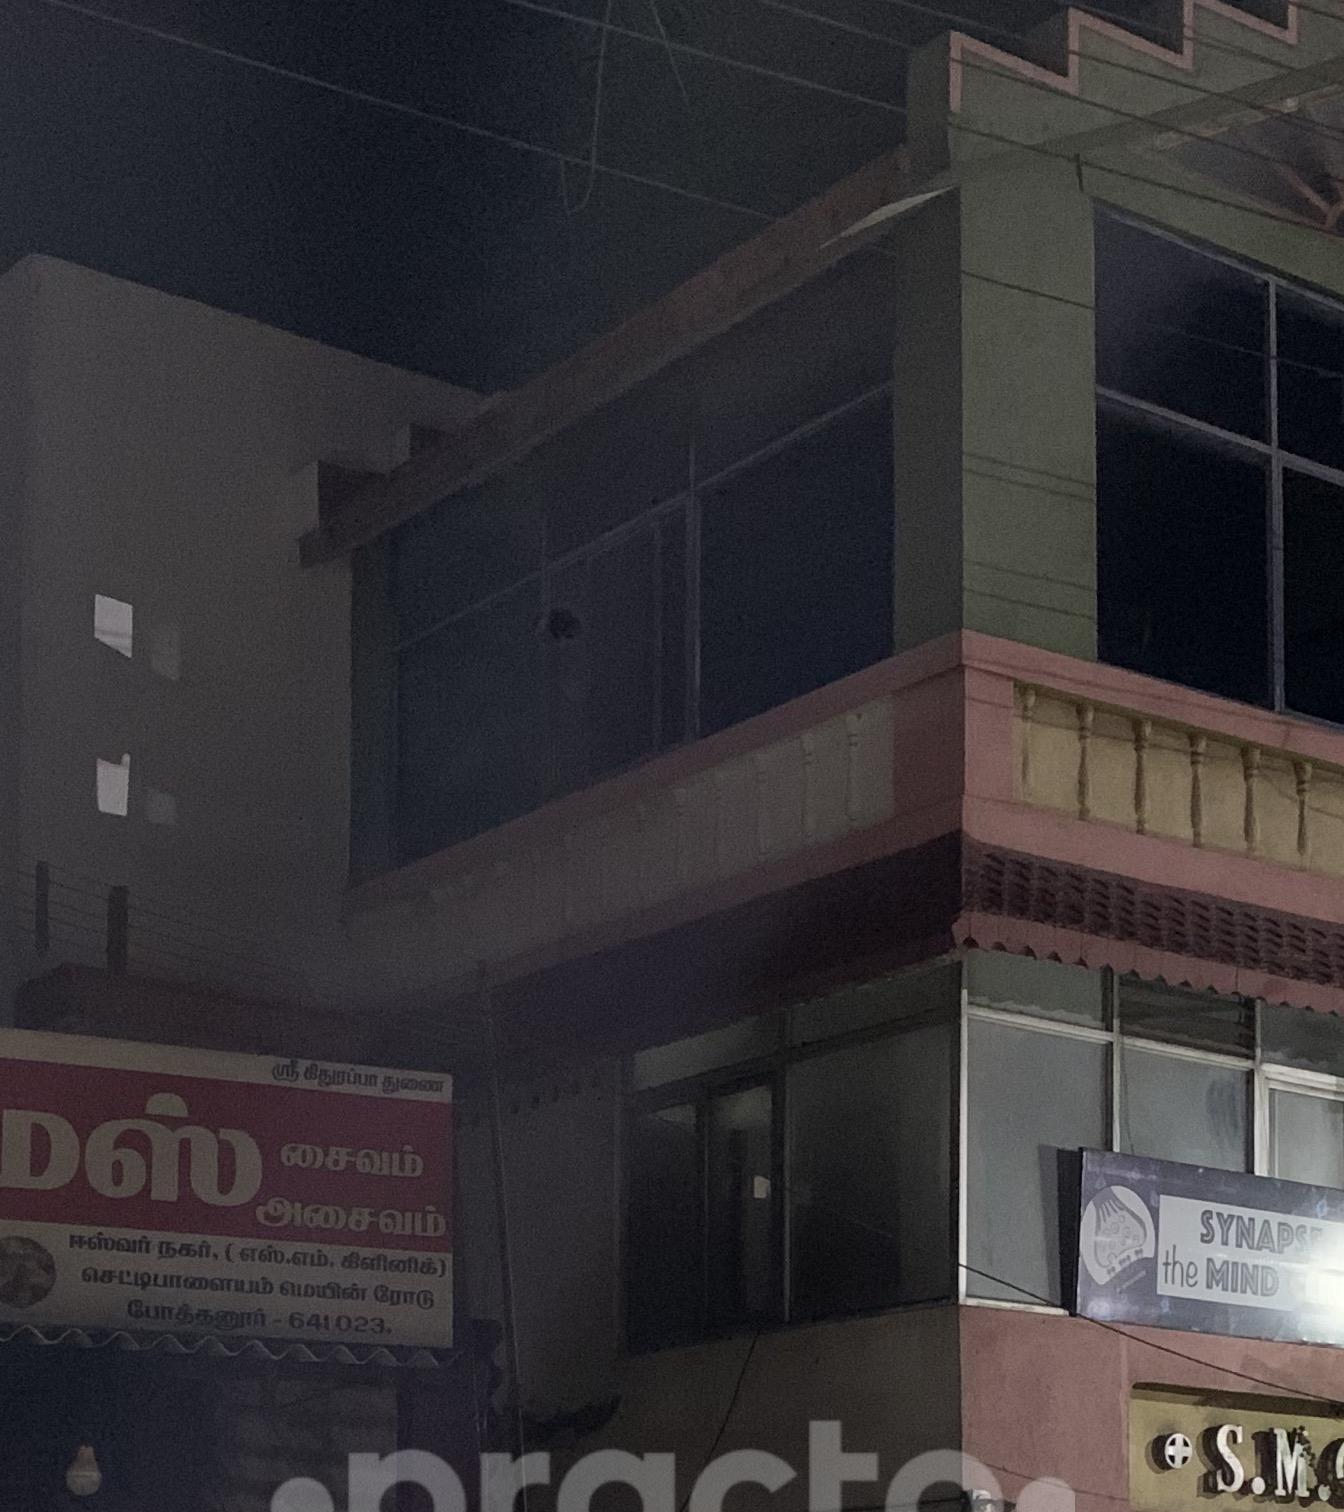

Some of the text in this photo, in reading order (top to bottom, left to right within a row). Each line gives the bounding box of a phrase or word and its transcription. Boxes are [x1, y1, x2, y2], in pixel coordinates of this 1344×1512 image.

[381, 1074, 444, 1094] துணை
[280, 1143, 424, 1178] சைவம்
[255, 1196, 447, 1237] அசைவம்
[68, 1231, 152, 1255] ஈஸ்வர்
[81, 1265, 435, 1310] செட்டிபாளையம் மெயின் ரோடு
[1162, 1249, 1198, 1289] the
[1206, 1257, 1279, 1298] MIND
[126, 1298, 267, 1330] போத்தனூர்
